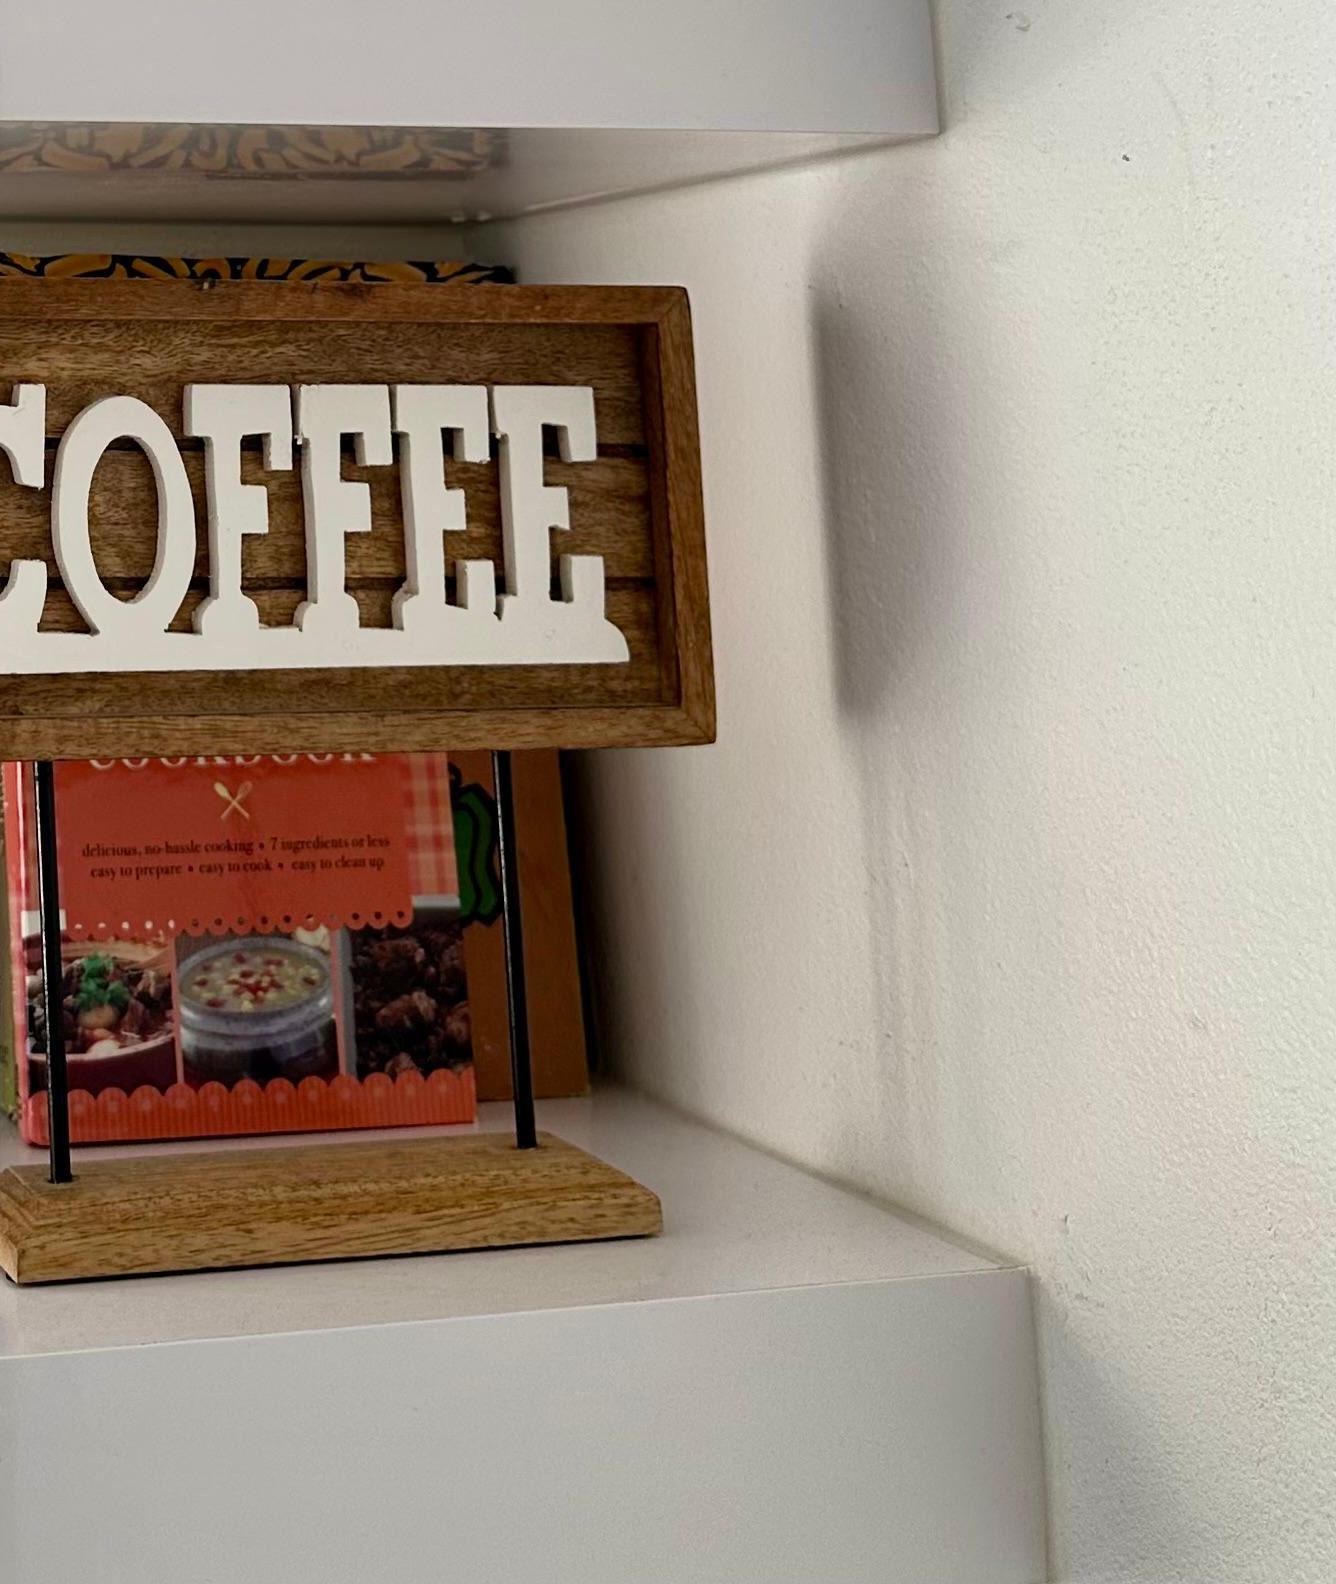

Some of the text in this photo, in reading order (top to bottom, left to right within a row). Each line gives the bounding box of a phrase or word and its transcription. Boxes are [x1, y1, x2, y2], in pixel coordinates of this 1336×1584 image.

[82, 834, 390, 857] delicious, no-hassle cooking 7 ingredients or less
[90, 855, 385, 881] easy to prepare easy to cook easy to clean up
